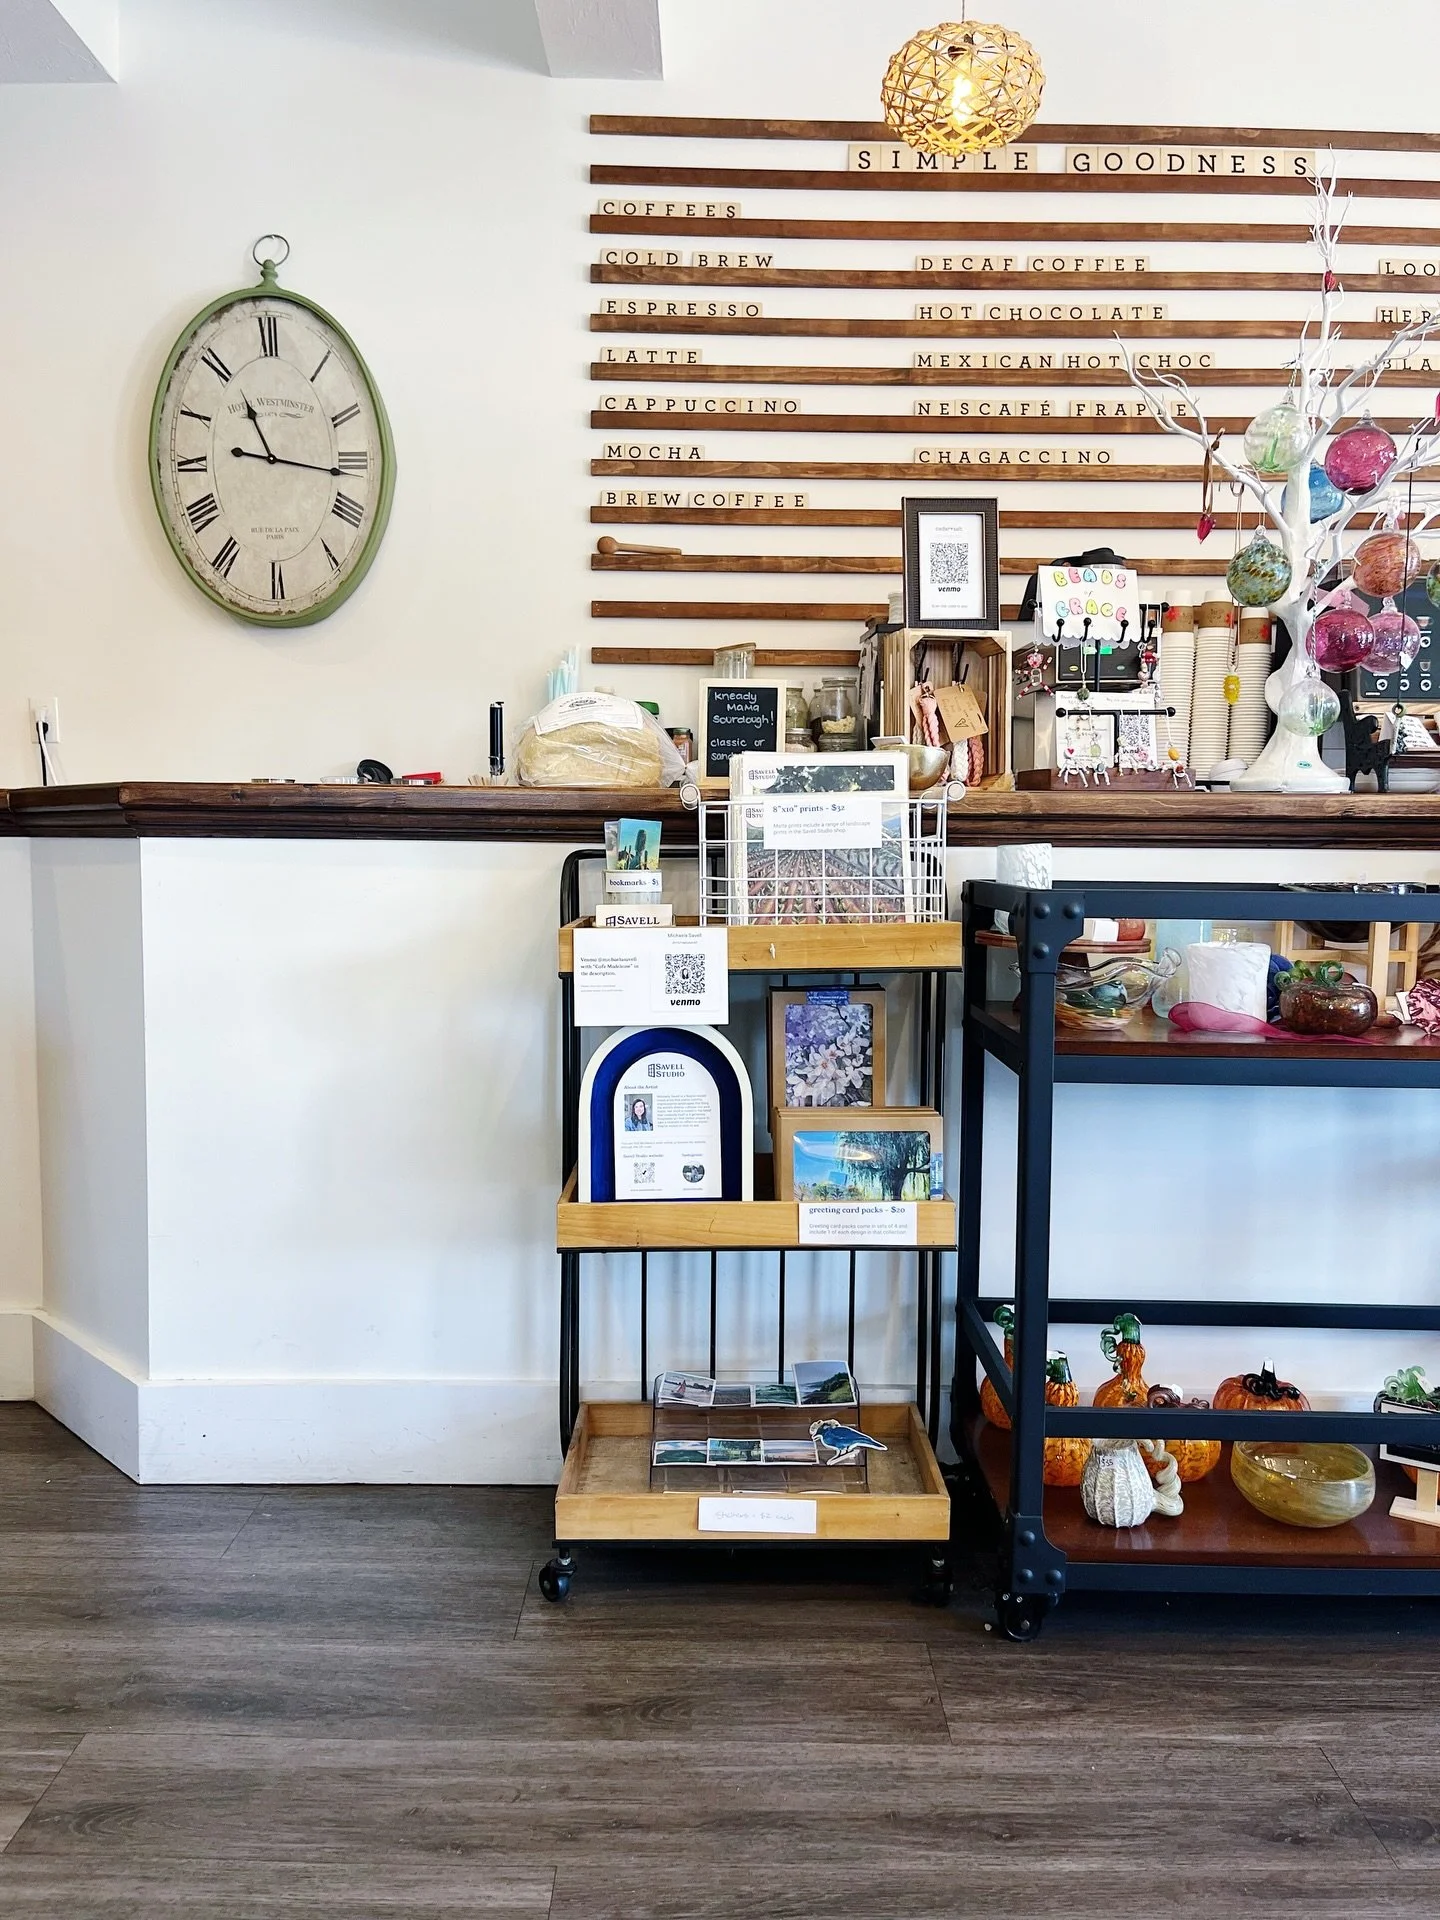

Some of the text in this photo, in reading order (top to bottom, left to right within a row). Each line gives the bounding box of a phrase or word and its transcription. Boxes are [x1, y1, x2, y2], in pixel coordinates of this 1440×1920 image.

[858, 151, 1307, 175] SIMPLE GOODNESS
[603, 202, 736, 218] COFFEES
[606, 251, 773, 268] COLD BREW
[921, 258, 1145, 272] DECAF COFFEE
[606, 301, 759, 318] ESPRESSO
[920, 306, 1163, 320] HOT CHOCOLATE
[606, 350, 698, 364] LATTE
[918, 354, 1211, 369] MEXICAN HOT CHOC
[257, 397, 315, 414] WESTMINSTER
[605, 397, 797, 414] CAPPUCCINO
[918, 400, 1051, 417] NESCAFÉ
[607, 445, 701, 461] MOCHA
[919, 450, 1111, 464] CHAGACCINO
[606, 492, 805, 508] BREW COFFEE
[710, 738, 766, 747] classic or
[800, 804, 824, 813] prints
[831, 803, 846, 813] $32
[617, 915, 661, 925] SAVELL
[809, 1206, 841, 1215] greeting
[861, 1206, 883, 1215] packs
[890, 1205, 906, 1214] $20
